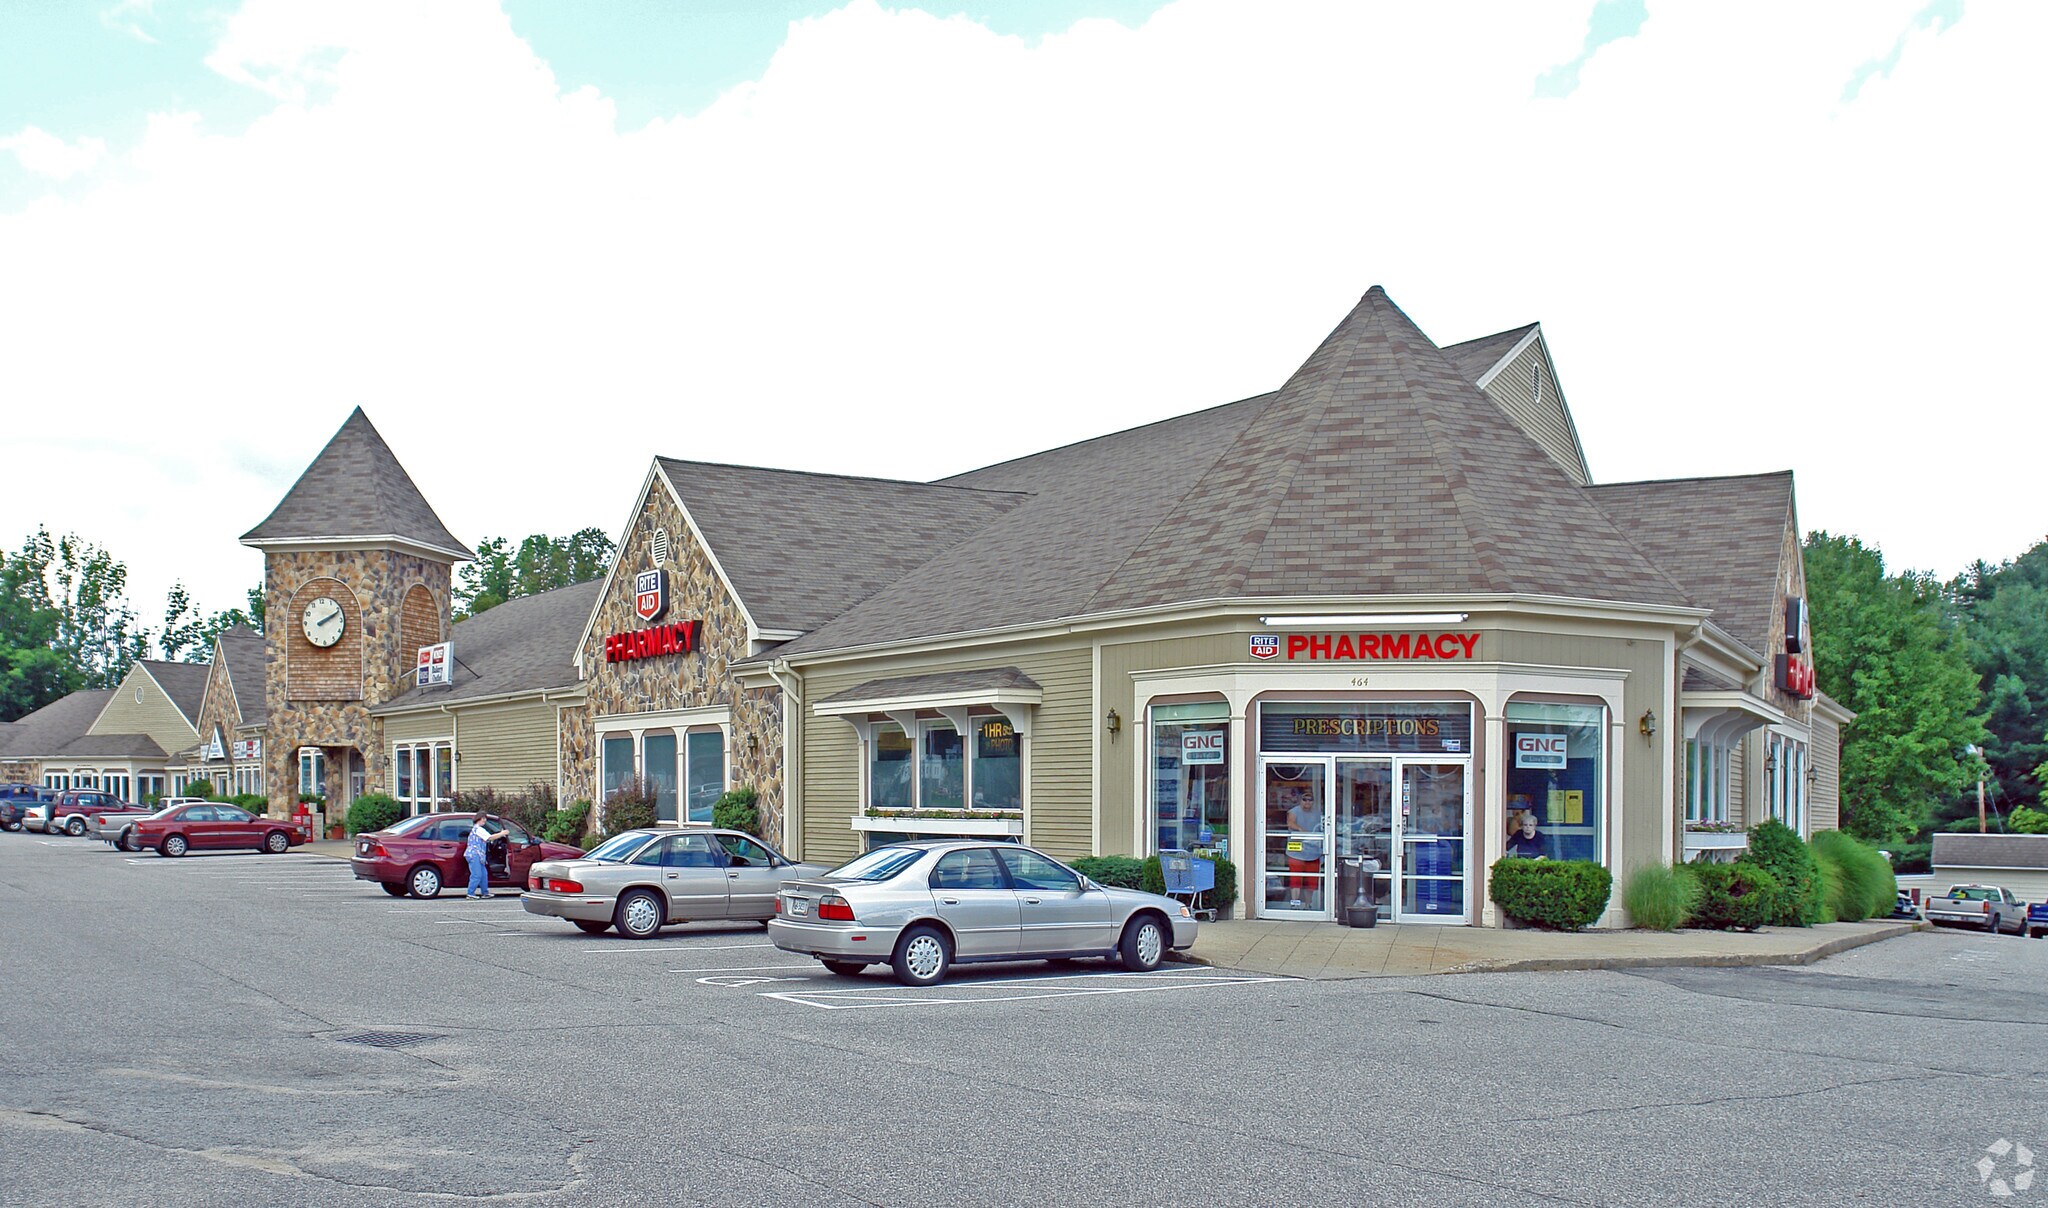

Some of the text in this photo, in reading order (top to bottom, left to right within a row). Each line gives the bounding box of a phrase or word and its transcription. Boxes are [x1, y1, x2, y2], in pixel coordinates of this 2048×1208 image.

[638, 573, 657, 592] RITE
[641, 594, 655, 611] AID
[605, 620, 695, 663] PHARMACY
[1254, 637, 1275, 645] RITE
[1287, 634, 1481, 660] PHARMACY
[1255, 646, 1273, 655] AID
[1351, 677, 1369, 687] 464
[1292, 718, 1440, 736] PRESCRIPTIONS
[1183, 735, 1222, 749] GNC
[1518, 738, 1565, 752] GNC
